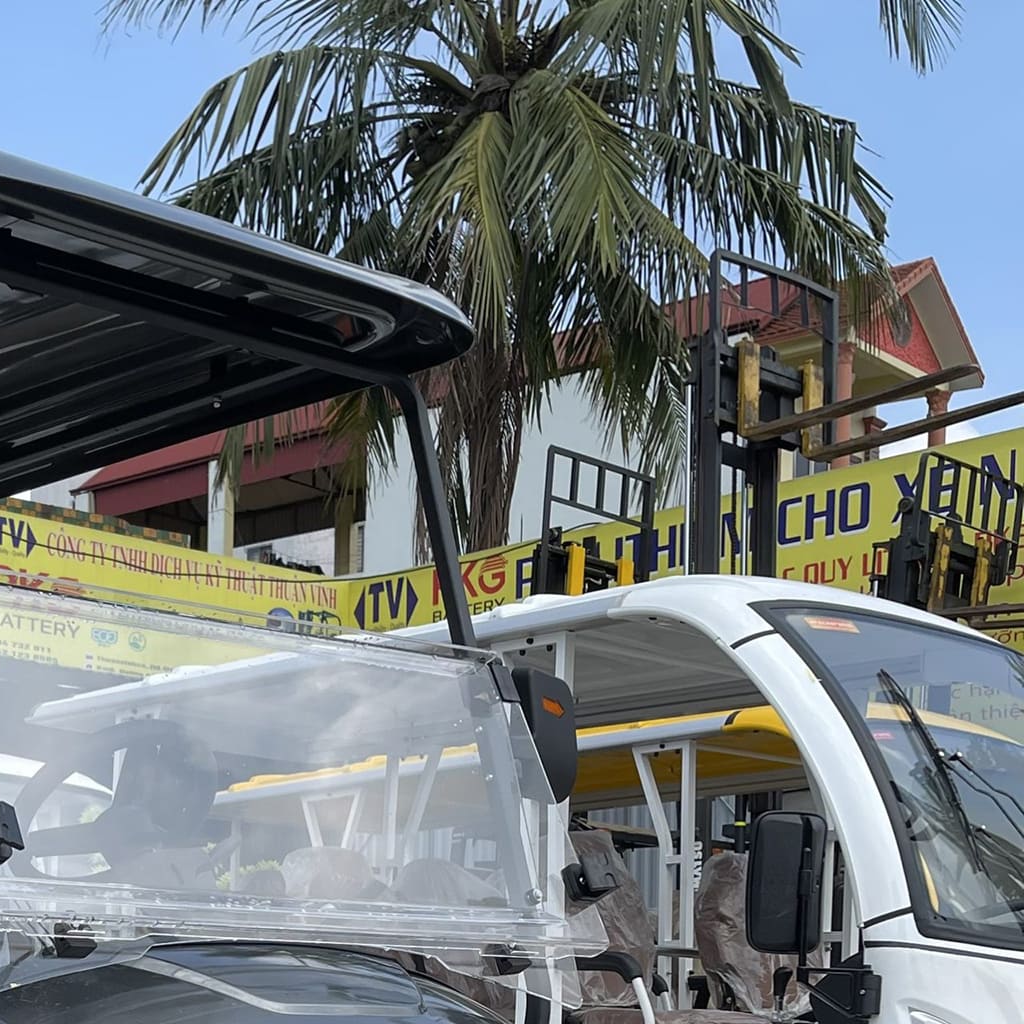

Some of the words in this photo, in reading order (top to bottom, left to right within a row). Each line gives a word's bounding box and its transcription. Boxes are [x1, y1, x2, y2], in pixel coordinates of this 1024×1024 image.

[777, 481, 871, 546] CHO
[47, 527, 85, 562] CÔNG
[91, 540, 107, 566] TY
[112, 544, 147, 574] TNHH
[151, 552, 182, 583] DỊCH
[368, 576, 405, 623] TV
